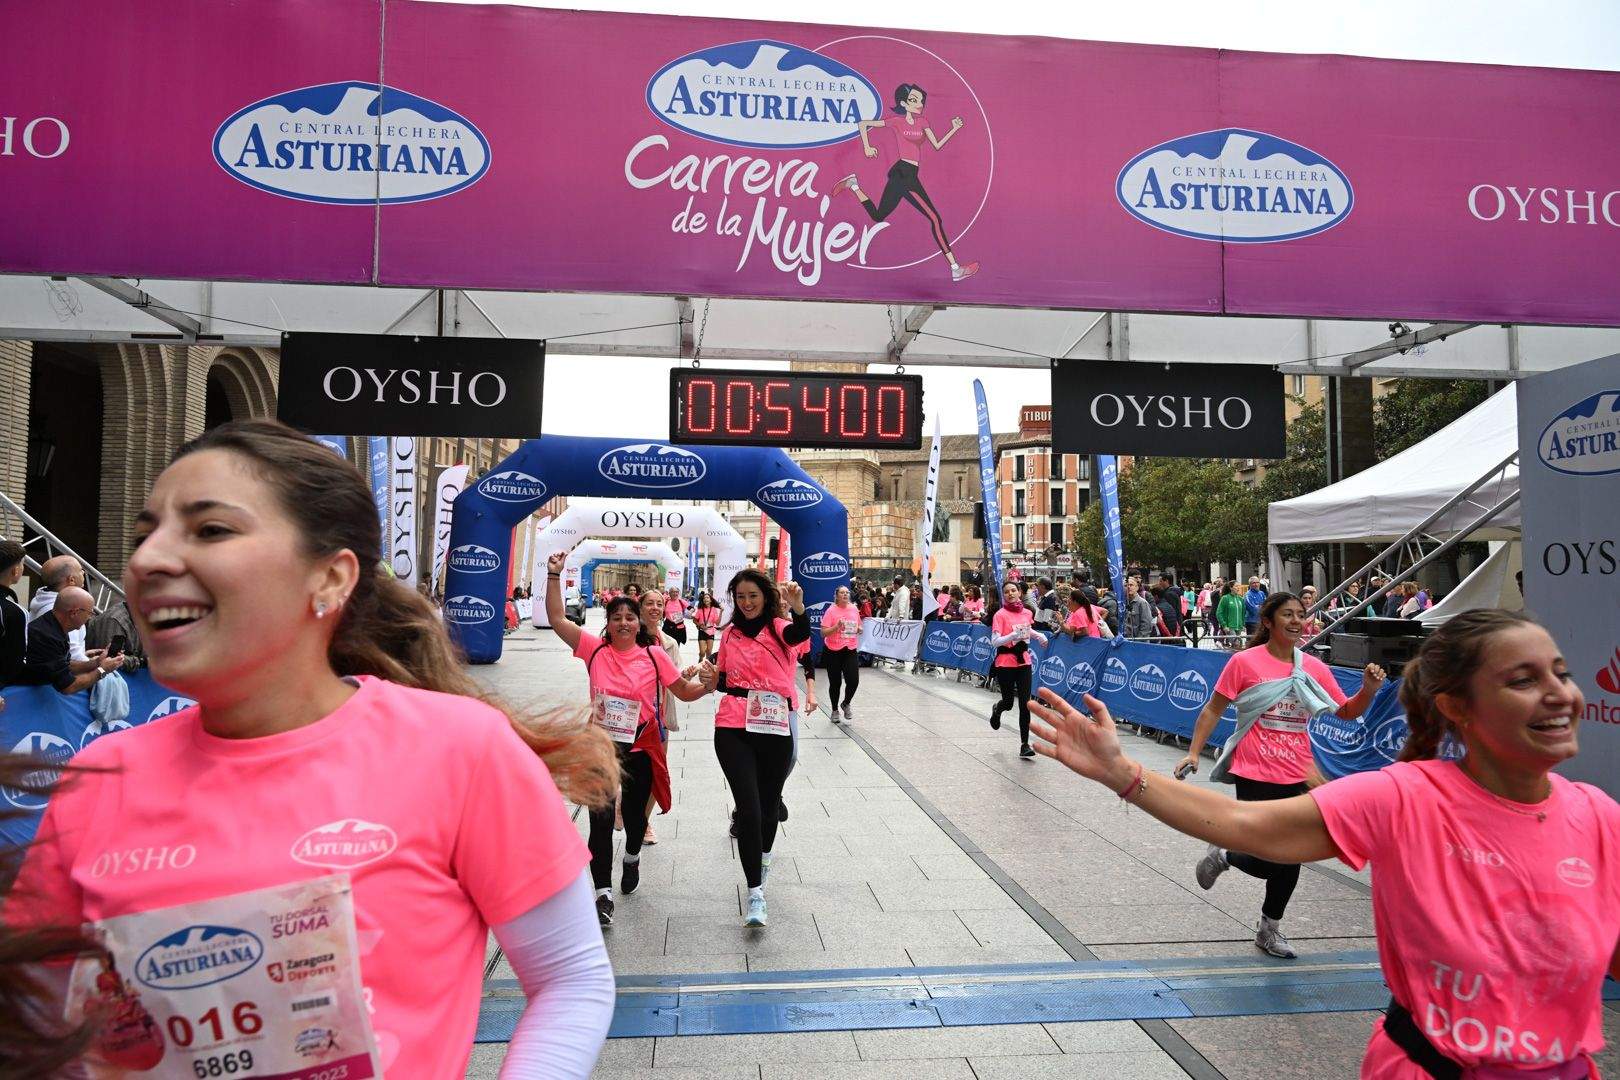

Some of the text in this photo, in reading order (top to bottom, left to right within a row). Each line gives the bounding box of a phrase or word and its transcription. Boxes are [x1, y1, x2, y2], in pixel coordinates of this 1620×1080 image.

[701, 74, 857, 93] CENTRAL LECHERA
[665, 75, 862, 125] ASTURIANA
[279, 121, 461, 140] CENTRAL LECHERA
[234, 122, 469, 176] ASTURIANA
[624, 134, 820, 198] Carrera
[1171, 165, 1328, 182] CENTRAL LECHERA
[1136, 166, 1336, 216] ASTURIANA
[671, 195, 892, 287] de la Mujer
[322, 366, 508, 408] OYSHO
[1089, 392, 1253, 430] OYSHO
[606, 456, 699, 478] ASTURIANA
[482, 481, 541, 496] ASTURIANA
[762, 490, 819, 502] ASTURIANA
[601, 510, 684, 529] OYSHO
[450, 553, 496, 567] ASTURIANA
[802, 562, 847, 574] ASTURIANA
[872, 621, 911, 642] OYSHO
[90, 844, 197, 879] OYSHO
[272, 914, 330, 939] SUMA
[145, 945, 255, 982] ASTURIANA
[287, 952, 335, 970] Zaragoza
[1429, 959, 1483, 1002] TU
[167, 1001, 264, 1048] 016
[192, 1050, 254, 1080] 6869
[309, 1064, 350, 1080] 2023
